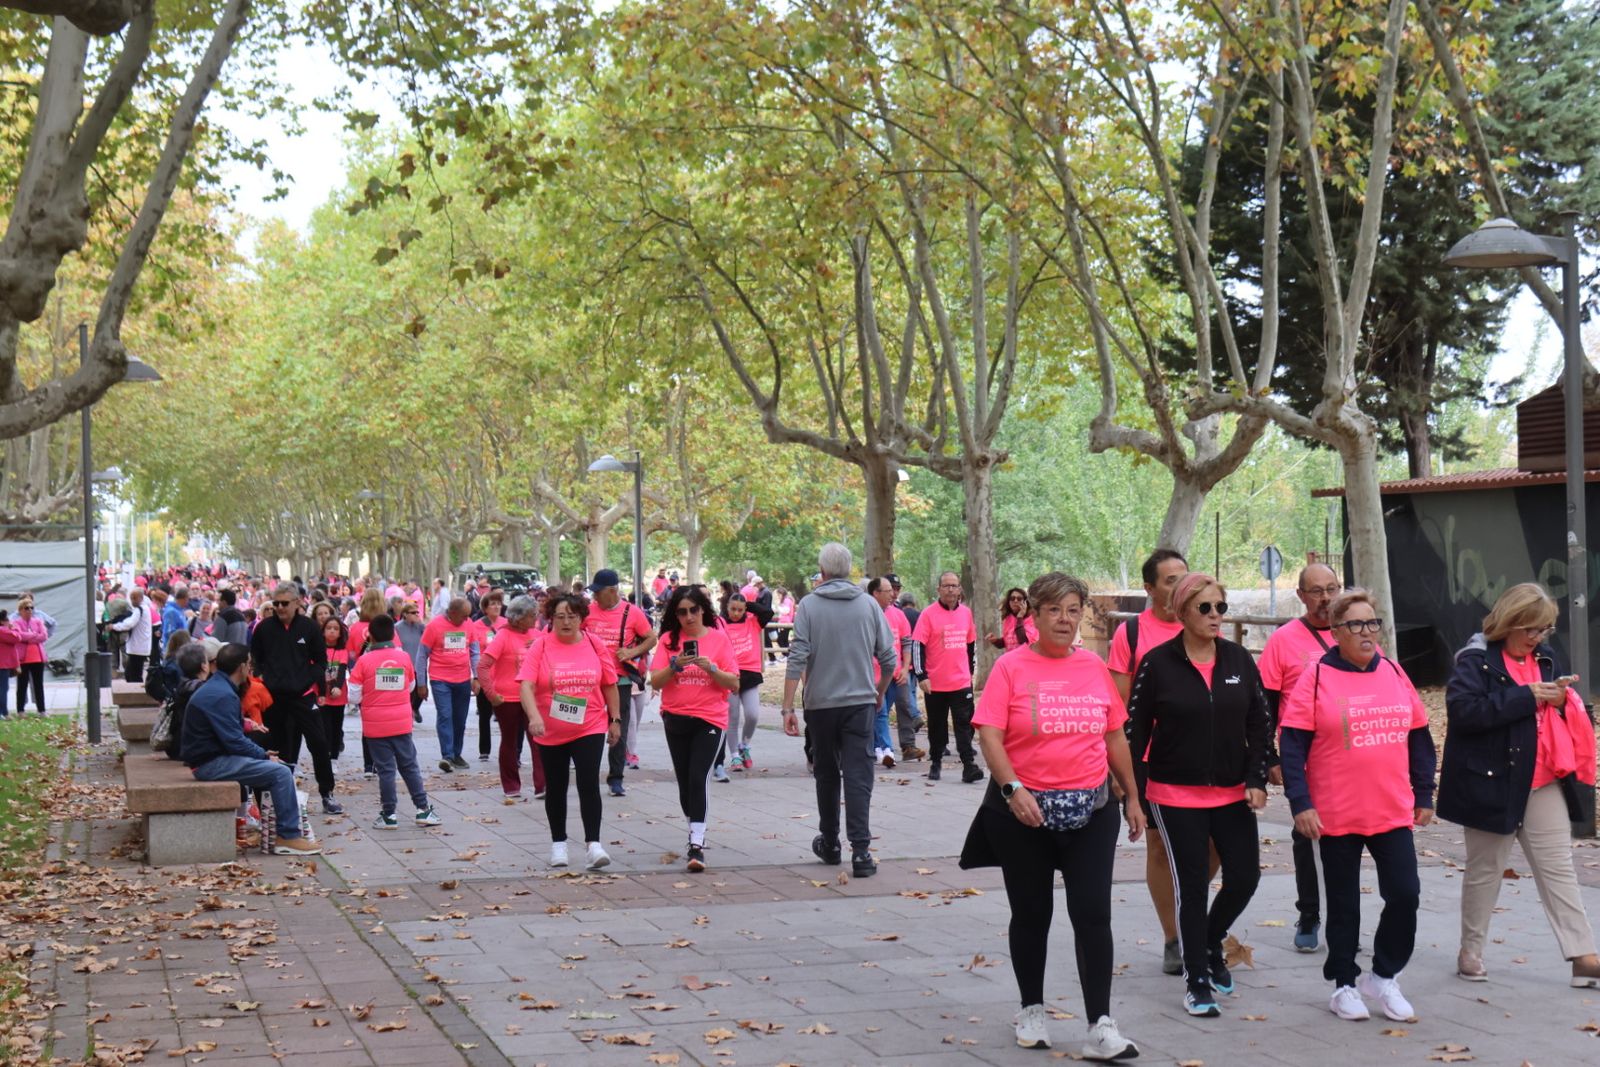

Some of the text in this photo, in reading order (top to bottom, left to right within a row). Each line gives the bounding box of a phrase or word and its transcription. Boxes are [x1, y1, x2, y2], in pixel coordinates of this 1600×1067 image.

[554, 677, 588, 685] contra
[1038, 693, 1055, 704] En
[558, 703, 579, 715] 9519
[1039, 706, 1104, 718] contra el
[1349, 707, 1366, 718] En
[1041, 717, 1105, 735] cáncer
[1350, 717, 1400, 732] contra
